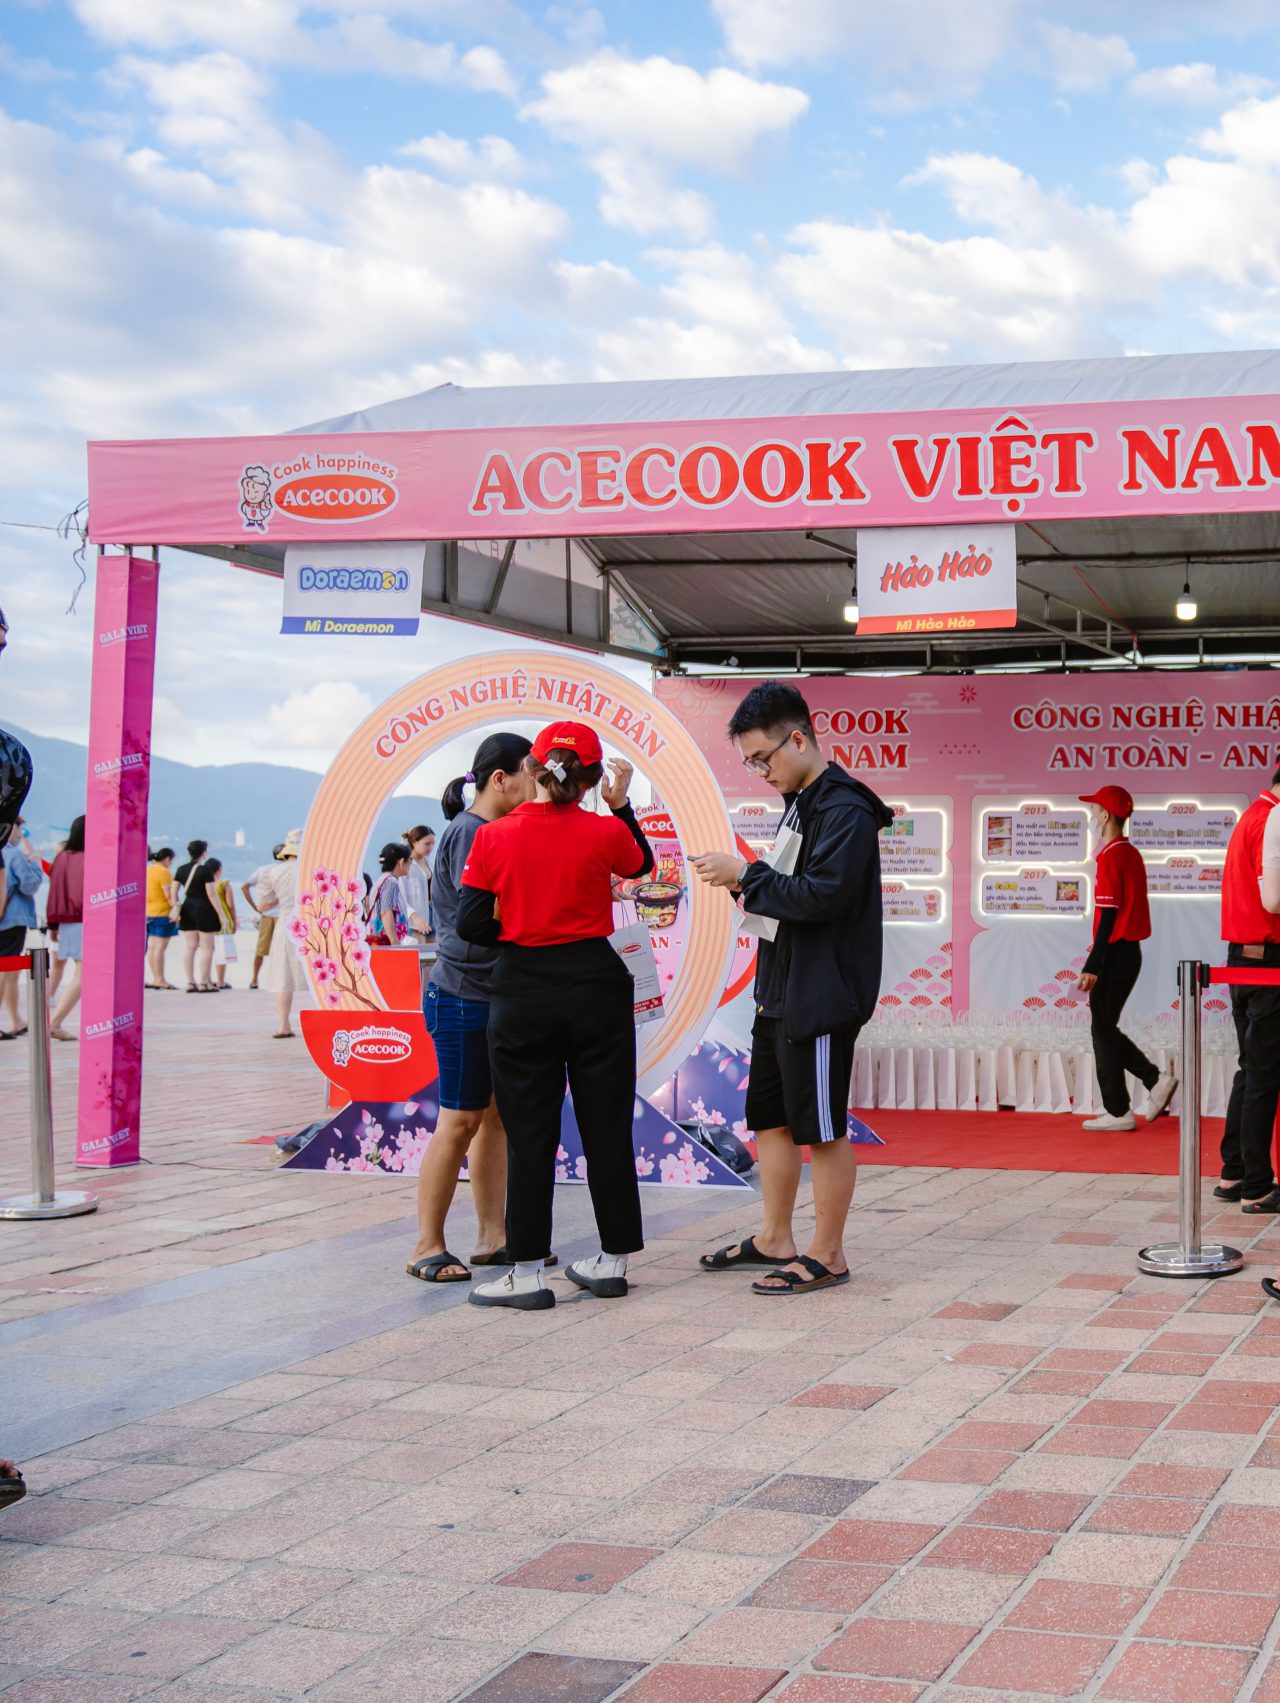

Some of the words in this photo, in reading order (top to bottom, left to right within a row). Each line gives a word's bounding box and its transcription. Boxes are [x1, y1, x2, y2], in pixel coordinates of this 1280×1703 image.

[273, 456, 312, 480] Cook
[316, 454, 396, 479] happiness
[473, 440, 867, 512] ACECOOK
[892, 415, 1094, 513] VIỆT
[879, 555, 935, 593] Hảo
[937, 544, 993, 582] Hảo
[299, 567, 409, 591] Doraemon
[304, 620, 321, 632] Mì
[324, 620, 395, 634] Doraemon
[896, 619, 913, 631] Mì
[916, 617, 944, 630] Hảo
[947, 615, 976, 628] Hảo
[100, 626, 128, 644] GALA
[375, 697, 445, 758] CÔNG
[450, 668, 528, 712] NGHỆ
[536, 676, 612, 717] NHẬT
[611, 704, 667, 758] BẢN
[1014, 701, 1100, 729] CÔNG
[1112, 699, 1202, 735] NGHỆ
[810, 710, 910, 736] COOK
[831, 744, 908, 768] NAM
[1048, 745, 1096, 768] AN
[1102, 738, 1188, 768] TOÀN
[1222, 744, 1271, 767] AN
[94, 758, 122, 774] GALA
[635, 803, 658, 816] Cook
[742, 808, 764, 816] 1993
[1024, 807, 1048, 815] 2013
[1171, 806, 1196, 814] 2020
[1170, 860, 1194, 868] 2022
[1024, 872, 1048, 880] 2017
[90, 888, 118, 905] GALA
[86, 1020, 114, 1036] GALA
[350, 1028, 370, 1040] Cook
[372, 1027, 410, 1042] happiness
